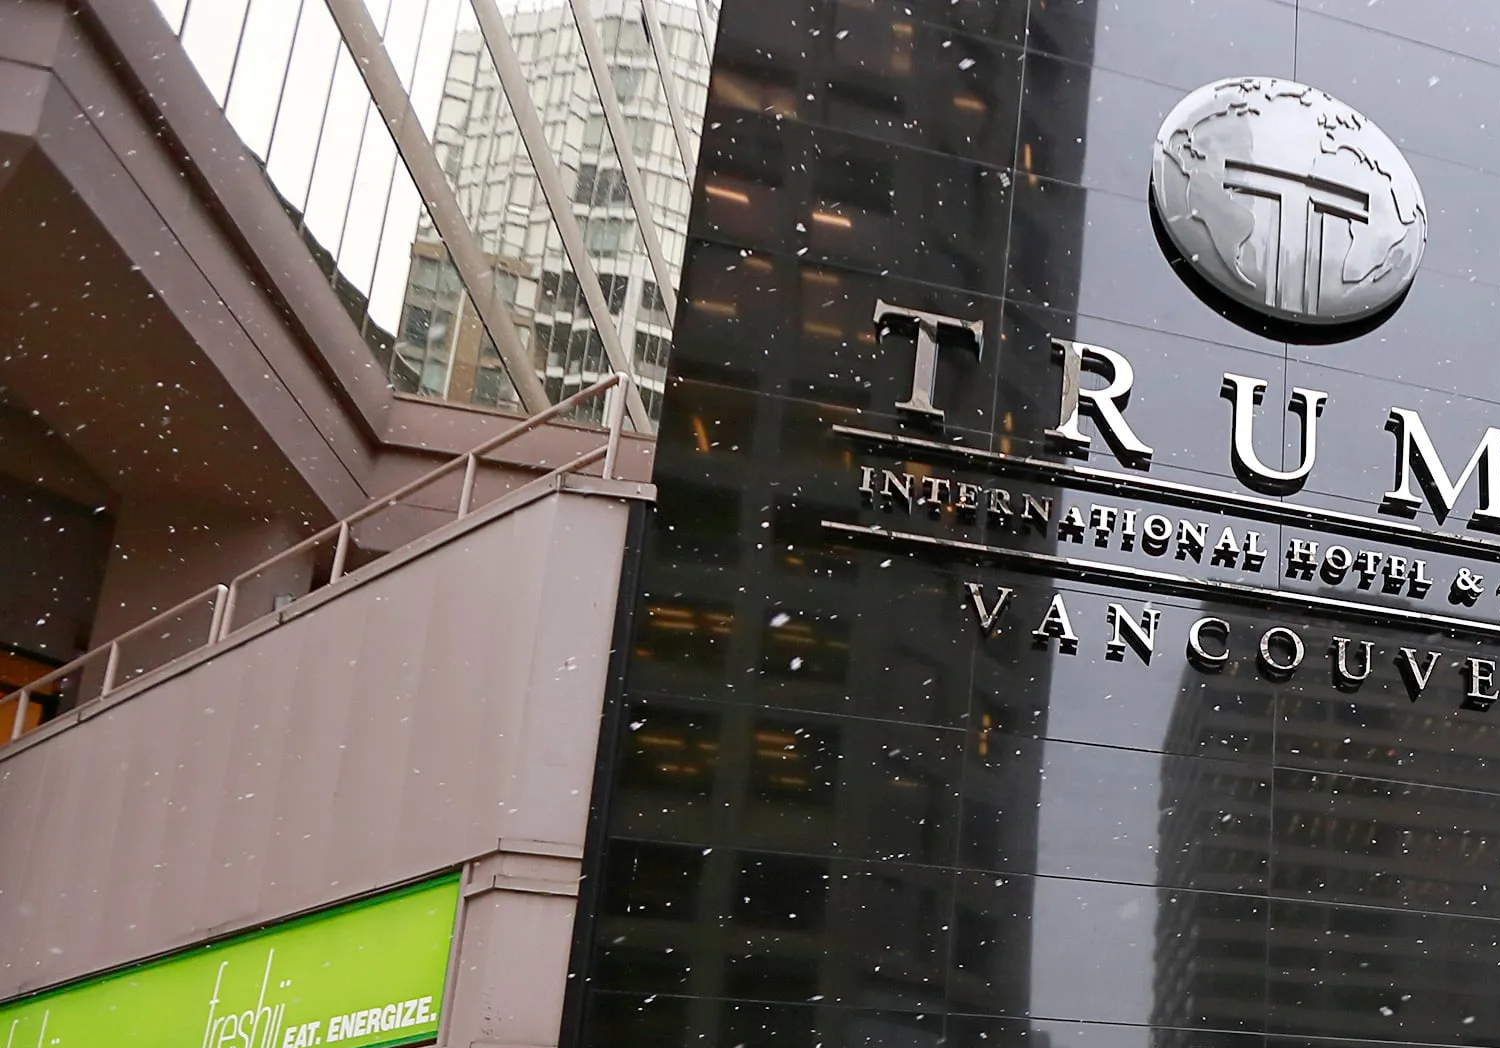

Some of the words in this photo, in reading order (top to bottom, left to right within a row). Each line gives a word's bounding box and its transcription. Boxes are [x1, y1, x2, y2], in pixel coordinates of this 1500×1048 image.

[857, 465, 1267, 560] INTERNATIONAL
[1290, 537, 1434, 590] HOTEL
[1455, 566, 1485, 594] &
[325, 995, 437, 1043] ENERGIZE.
